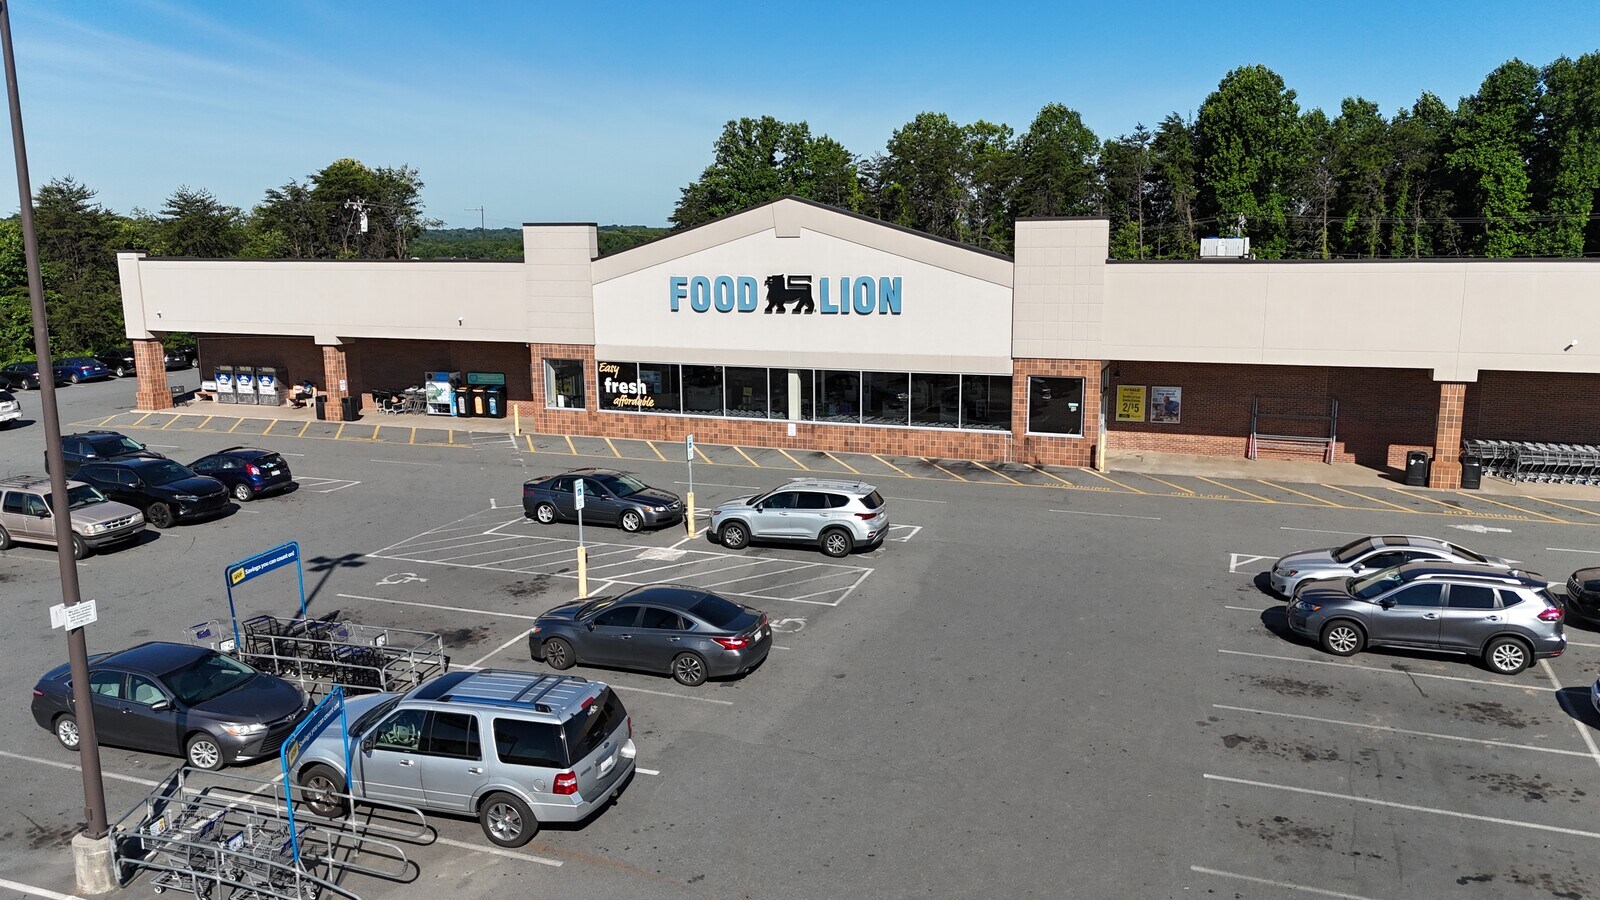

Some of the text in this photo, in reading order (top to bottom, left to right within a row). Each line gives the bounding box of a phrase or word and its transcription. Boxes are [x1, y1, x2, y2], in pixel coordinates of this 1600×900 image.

[669, 275, 903, 316] FOOD LION
[599, 362, 620, 379] Easy
[604, 377, 647, 395] fresh
[613, 394, 655, 407] affordable
[1122, 402, 1140, 413] 2/$5
[245, 565, 261, 575] Savings
[261, 561, 269, 569] you
[277, 553, 288, 562] count
